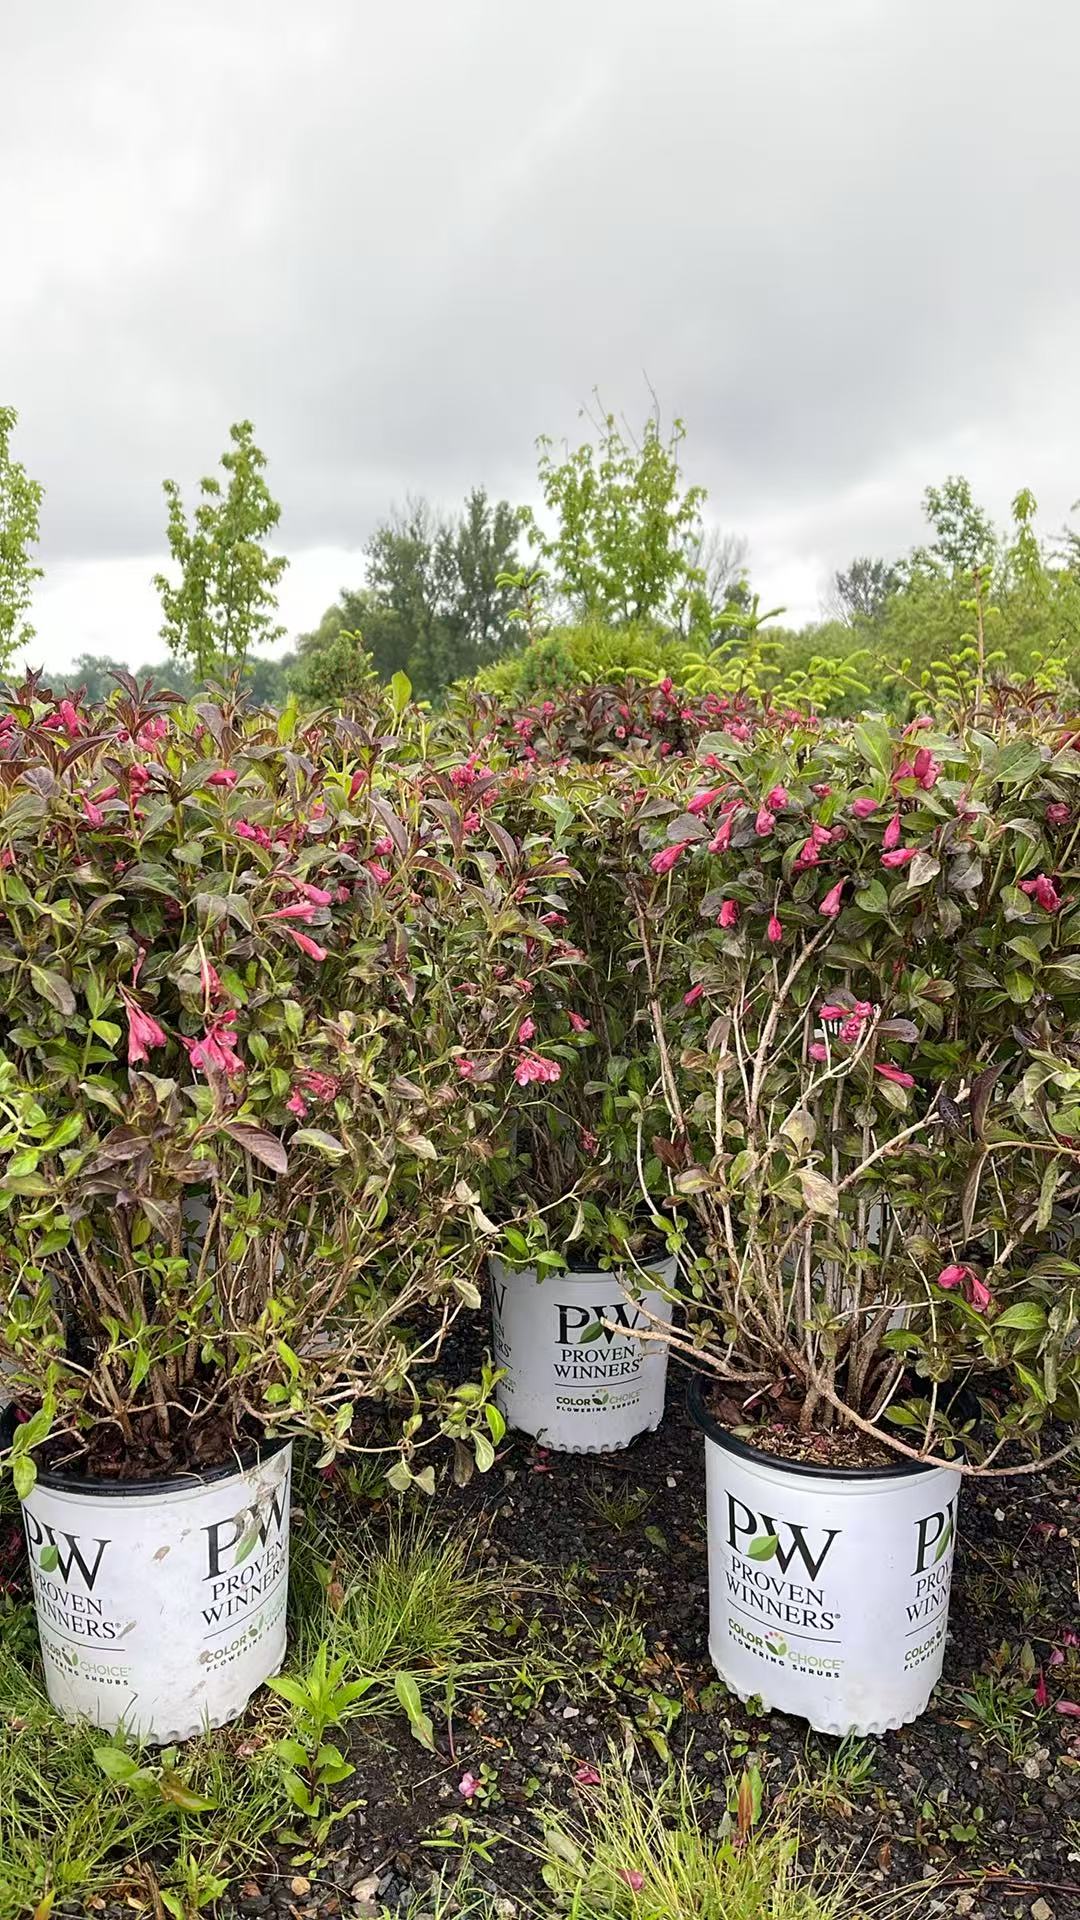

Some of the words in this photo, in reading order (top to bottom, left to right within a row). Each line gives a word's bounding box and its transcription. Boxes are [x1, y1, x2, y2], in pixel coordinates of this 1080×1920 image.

[553, 1297, 648, 1346] PW
[561, 1343, 636, 1363] PROVEN
[556, 1396, 591, 1406] COLOR
[23, 1503, 112, 1592] PW
[724, 1489, 843, 1582] PW
[212, 1540, 284, 1601] PROVEN
[731, 1554, 825, 1608] PROVEN
[206, 1634, 247, 1664] COLOR
[728, 1618, 763, 1648] COLOR
[905, 1635, 935, 1662] COLOR
[728, 1630, 785, 1667] FLOWERING
[792, 1664, 841, 1679] SHRUBS
[85, 1673, 129, 1686] SHRUBS
